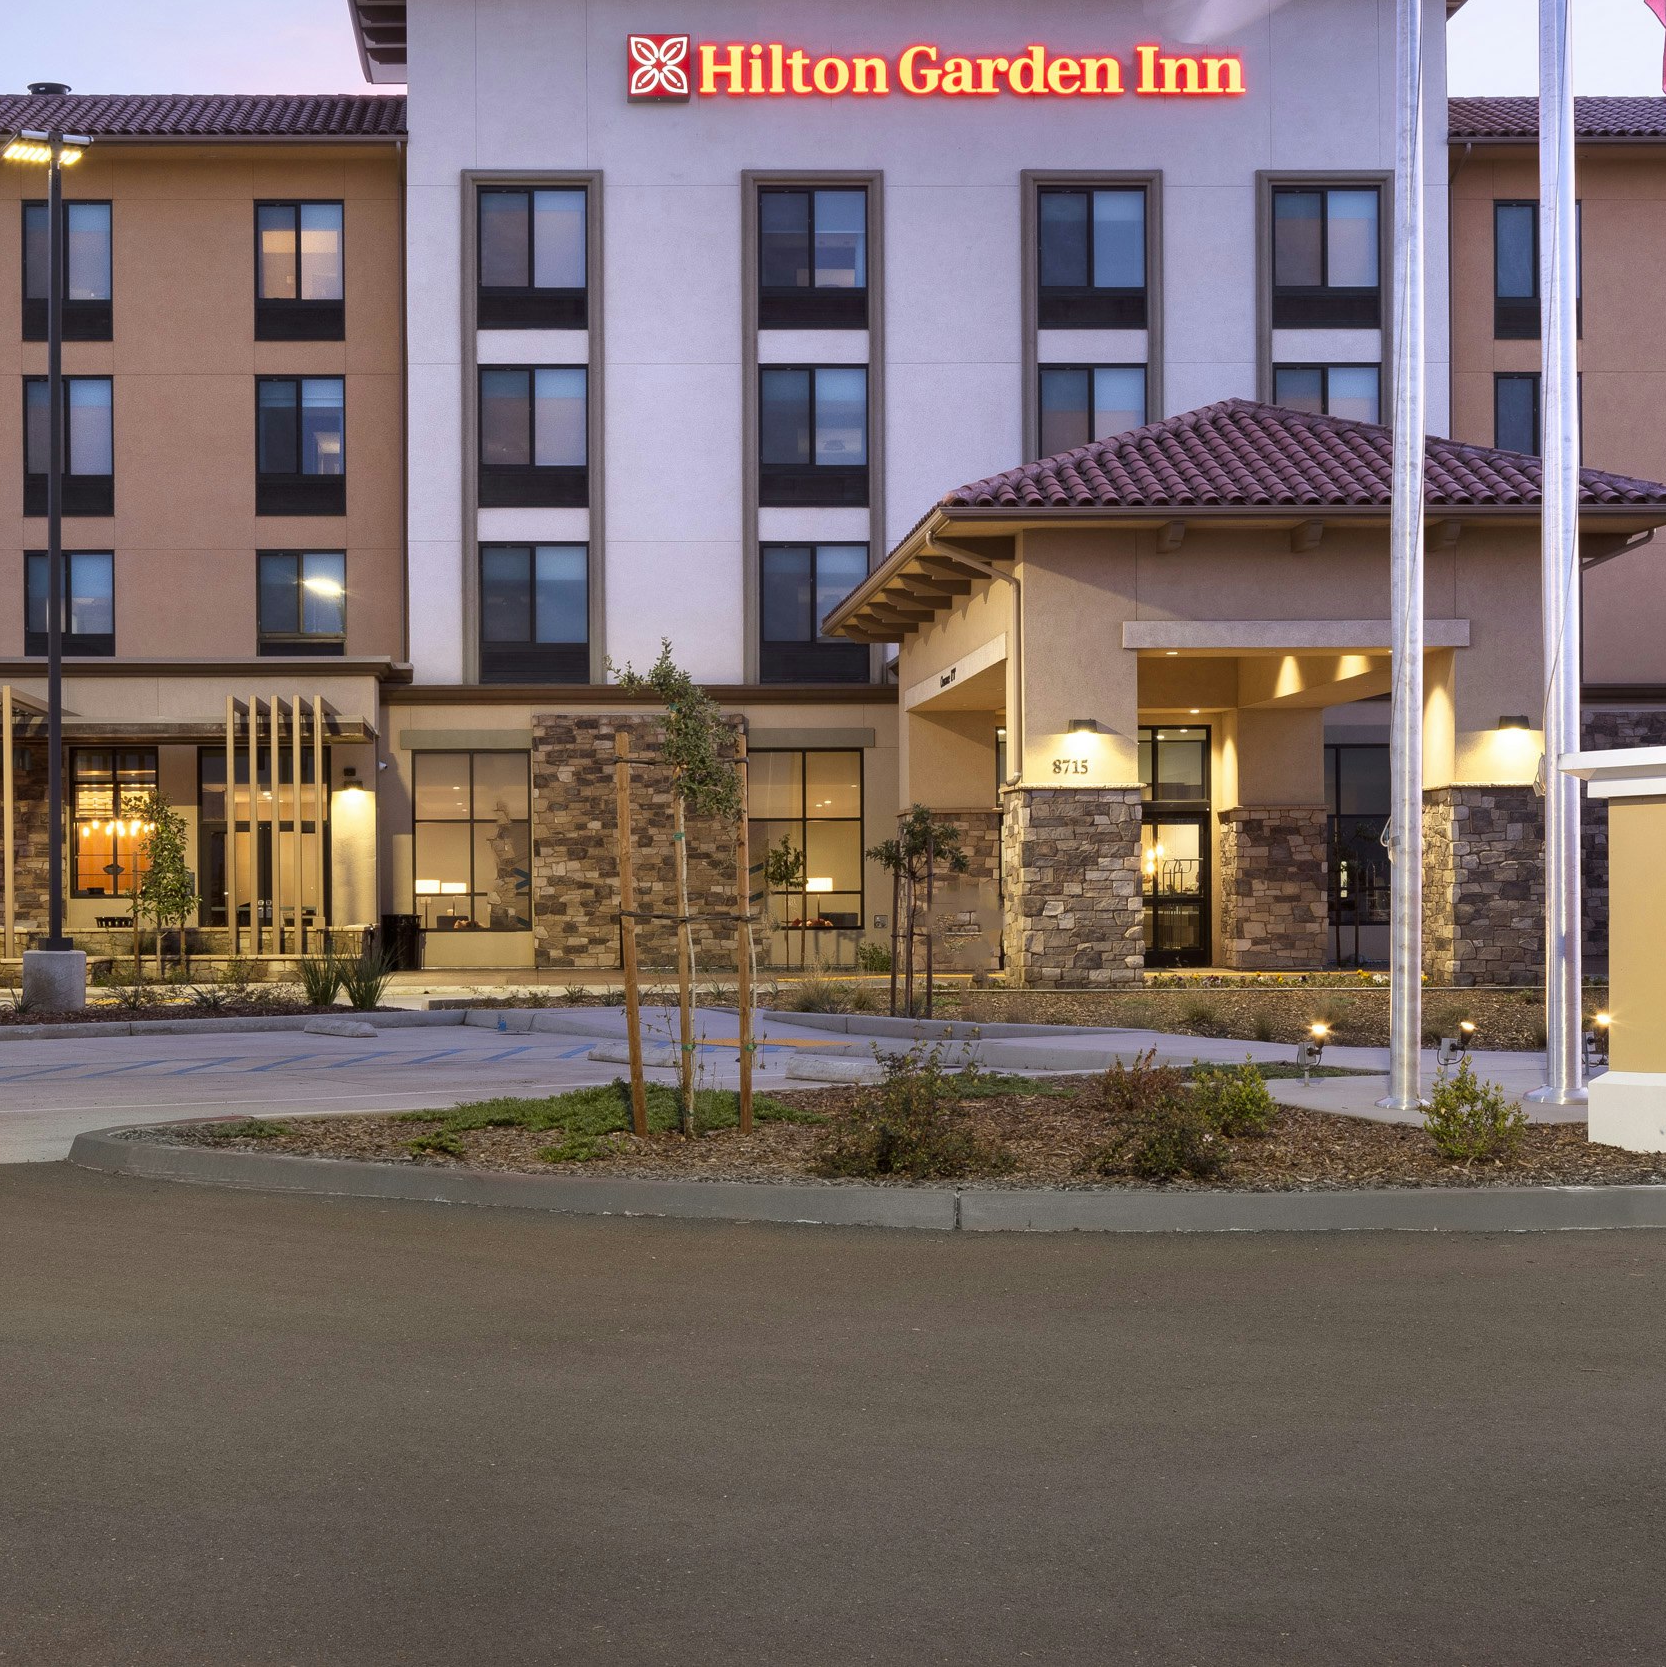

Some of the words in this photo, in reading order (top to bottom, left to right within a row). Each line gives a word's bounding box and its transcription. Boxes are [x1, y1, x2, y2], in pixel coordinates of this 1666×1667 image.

[698, 44, 889, 94] Hilton
[898, 45, 1124, 94] Garden
[1136, 46, 1246, 94] Inn
[1052, 759, 1089, 775] 8715
